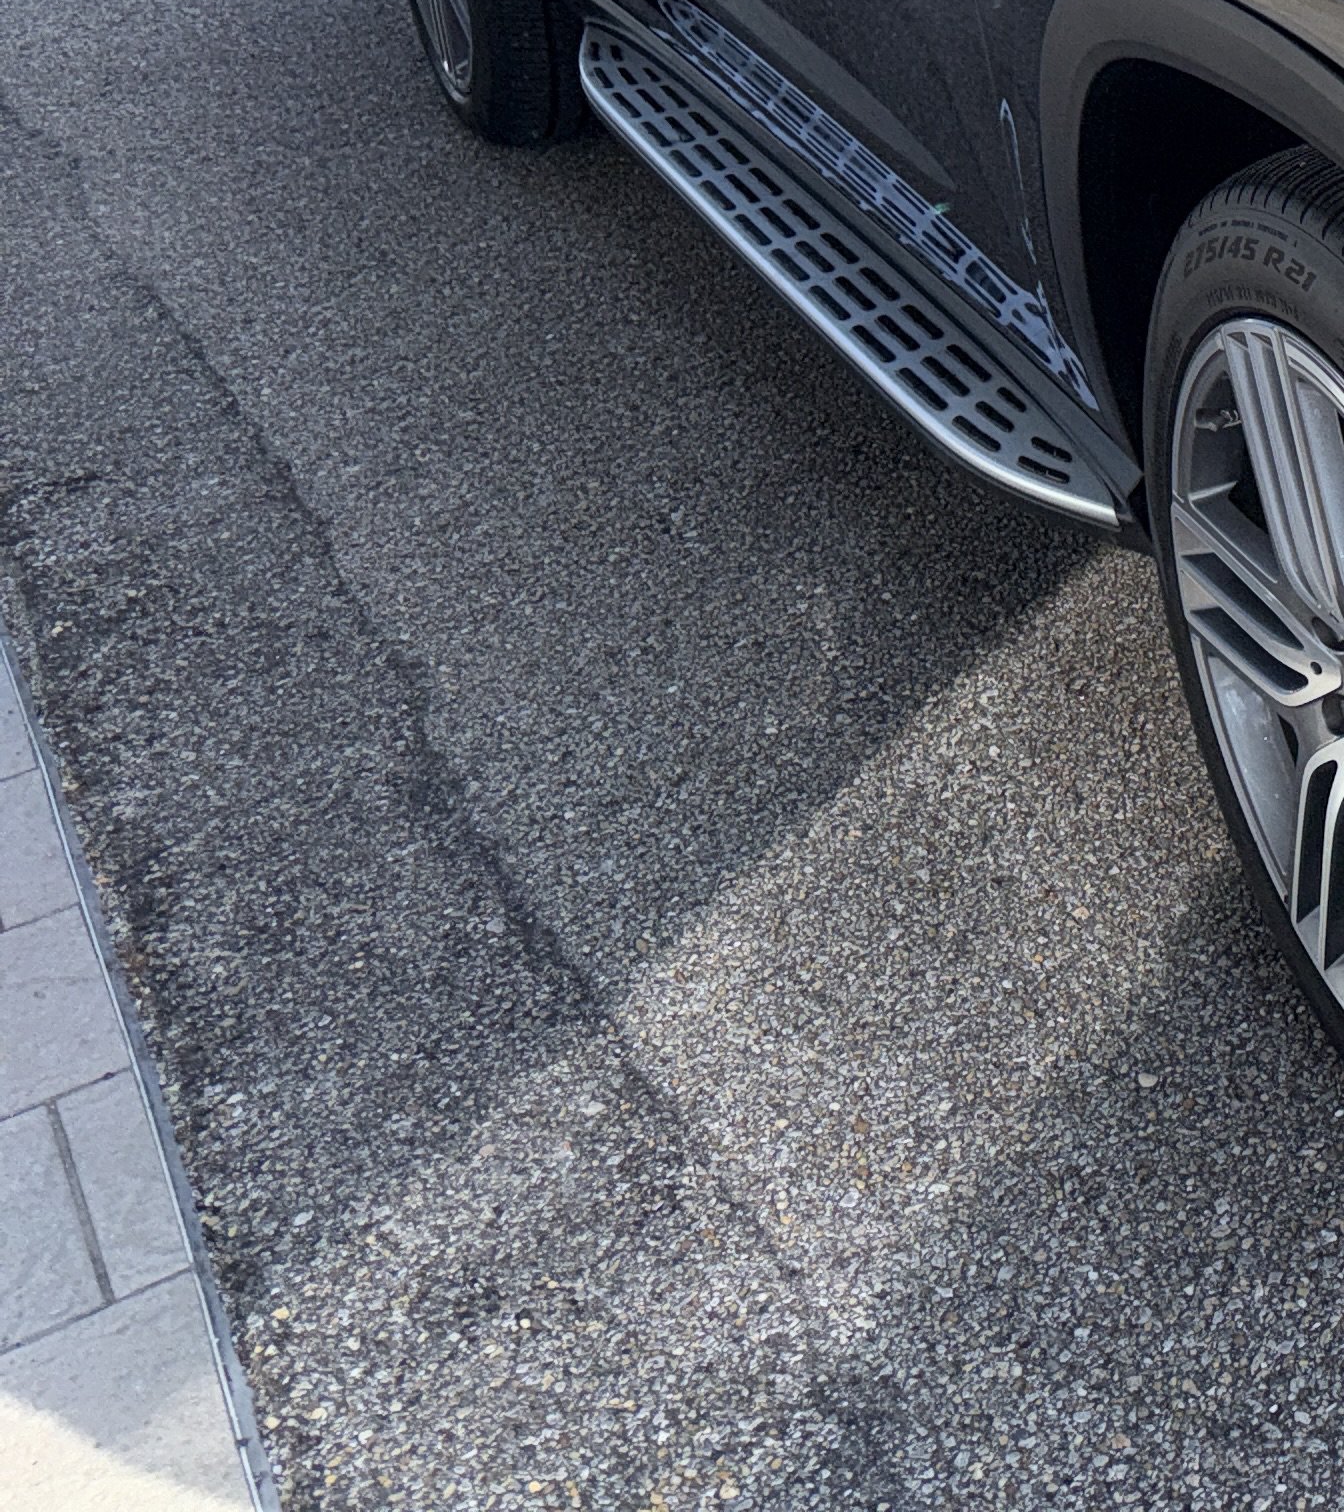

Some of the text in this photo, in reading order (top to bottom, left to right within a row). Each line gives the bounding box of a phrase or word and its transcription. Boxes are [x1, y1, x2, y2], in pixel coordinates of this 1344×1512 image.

[1183, 235, 1318, 293] 275/45 R 21
